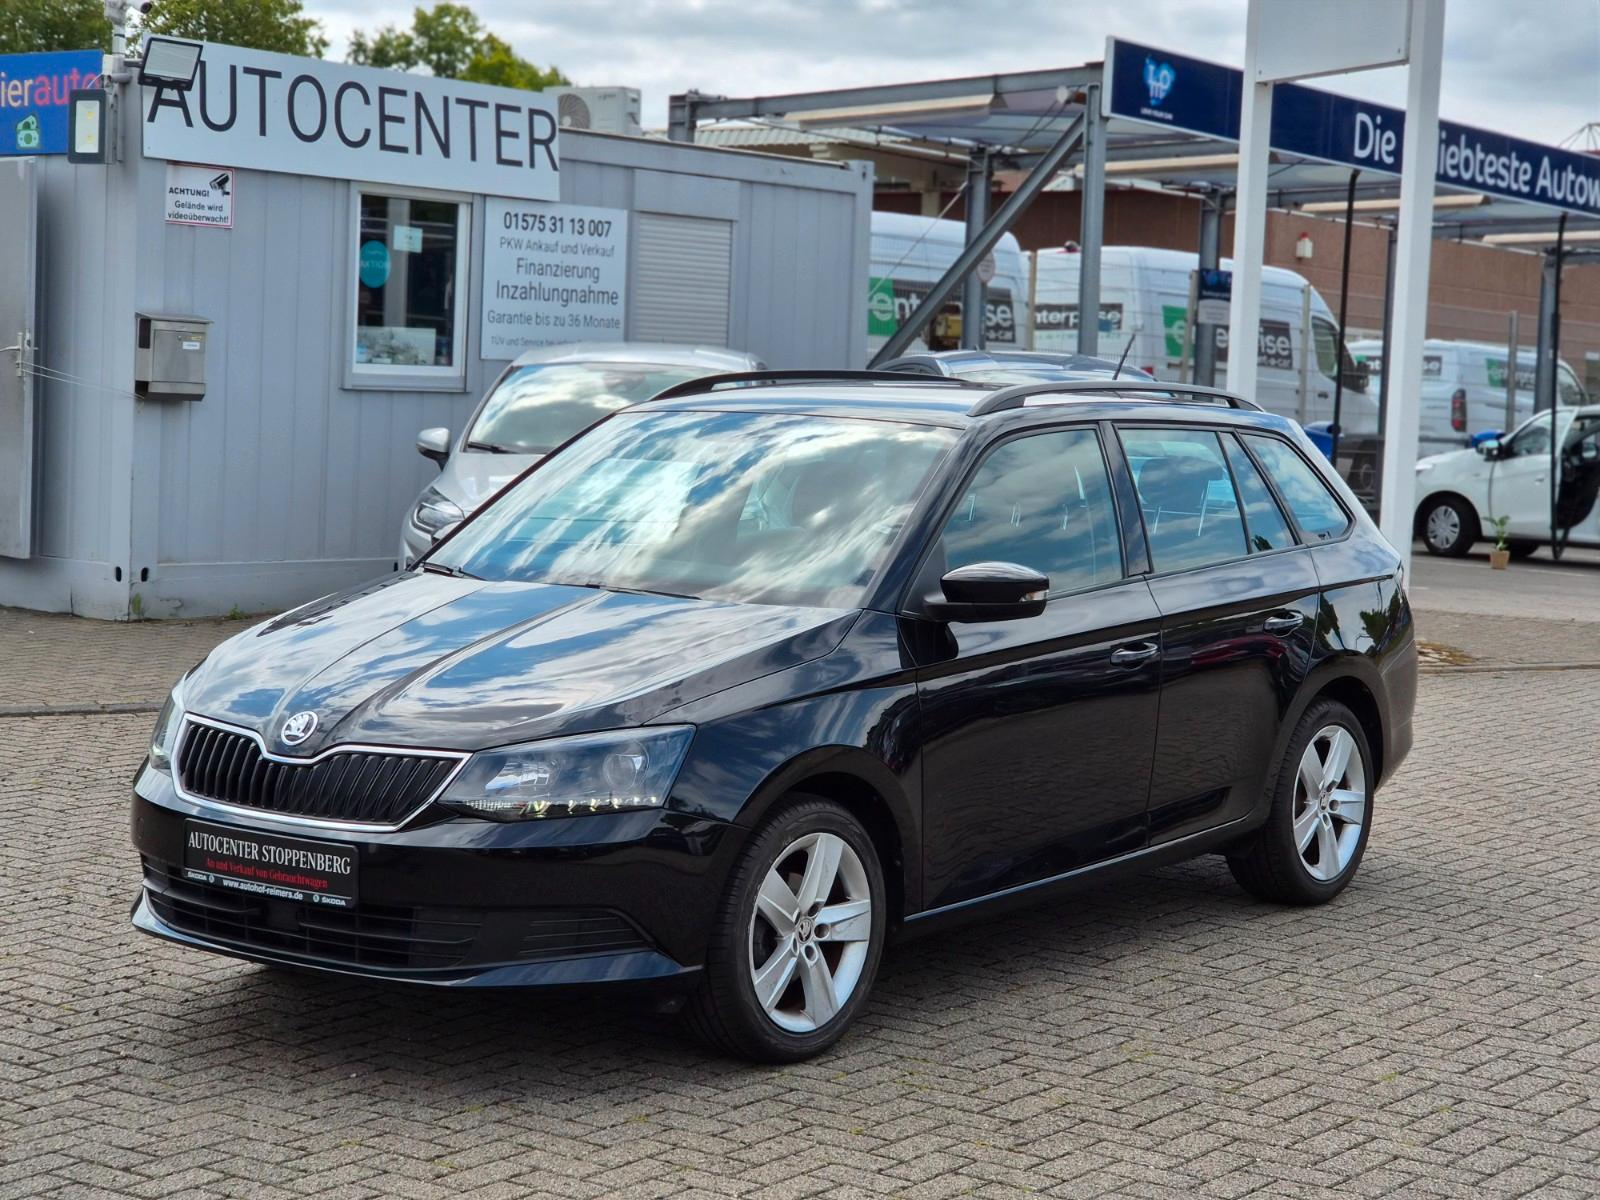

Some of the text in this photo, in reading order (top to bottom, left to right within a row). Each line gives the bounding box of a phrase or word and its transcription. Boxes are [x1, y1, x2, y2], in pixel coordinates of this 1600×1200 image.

[147, 60, 560, 172] AUTOCENTER
[1354, 112, 1396, 164] Die
[168, 187, 210, 198] ACHTUNG!
[167, 211, 229, 224] videoüberwacht!
[174, 200, 224, 212] Gelände wird
[503, 211, 612, 238] 01575 31 13 007
[500, 236, 615, 258] PKW Ankauf und Verkauf
[516, 257, 600, 284] Finanzierung
[496, 280, 619, 307] Inzahlungnahme
[487, 310, 621, 329] Garantie bis zu 36 Monate
[188, 831, 351, 875] AUTOCENTER STOPPENBERG
[222, 878, 303, 900] www.autohof-reimers.de
